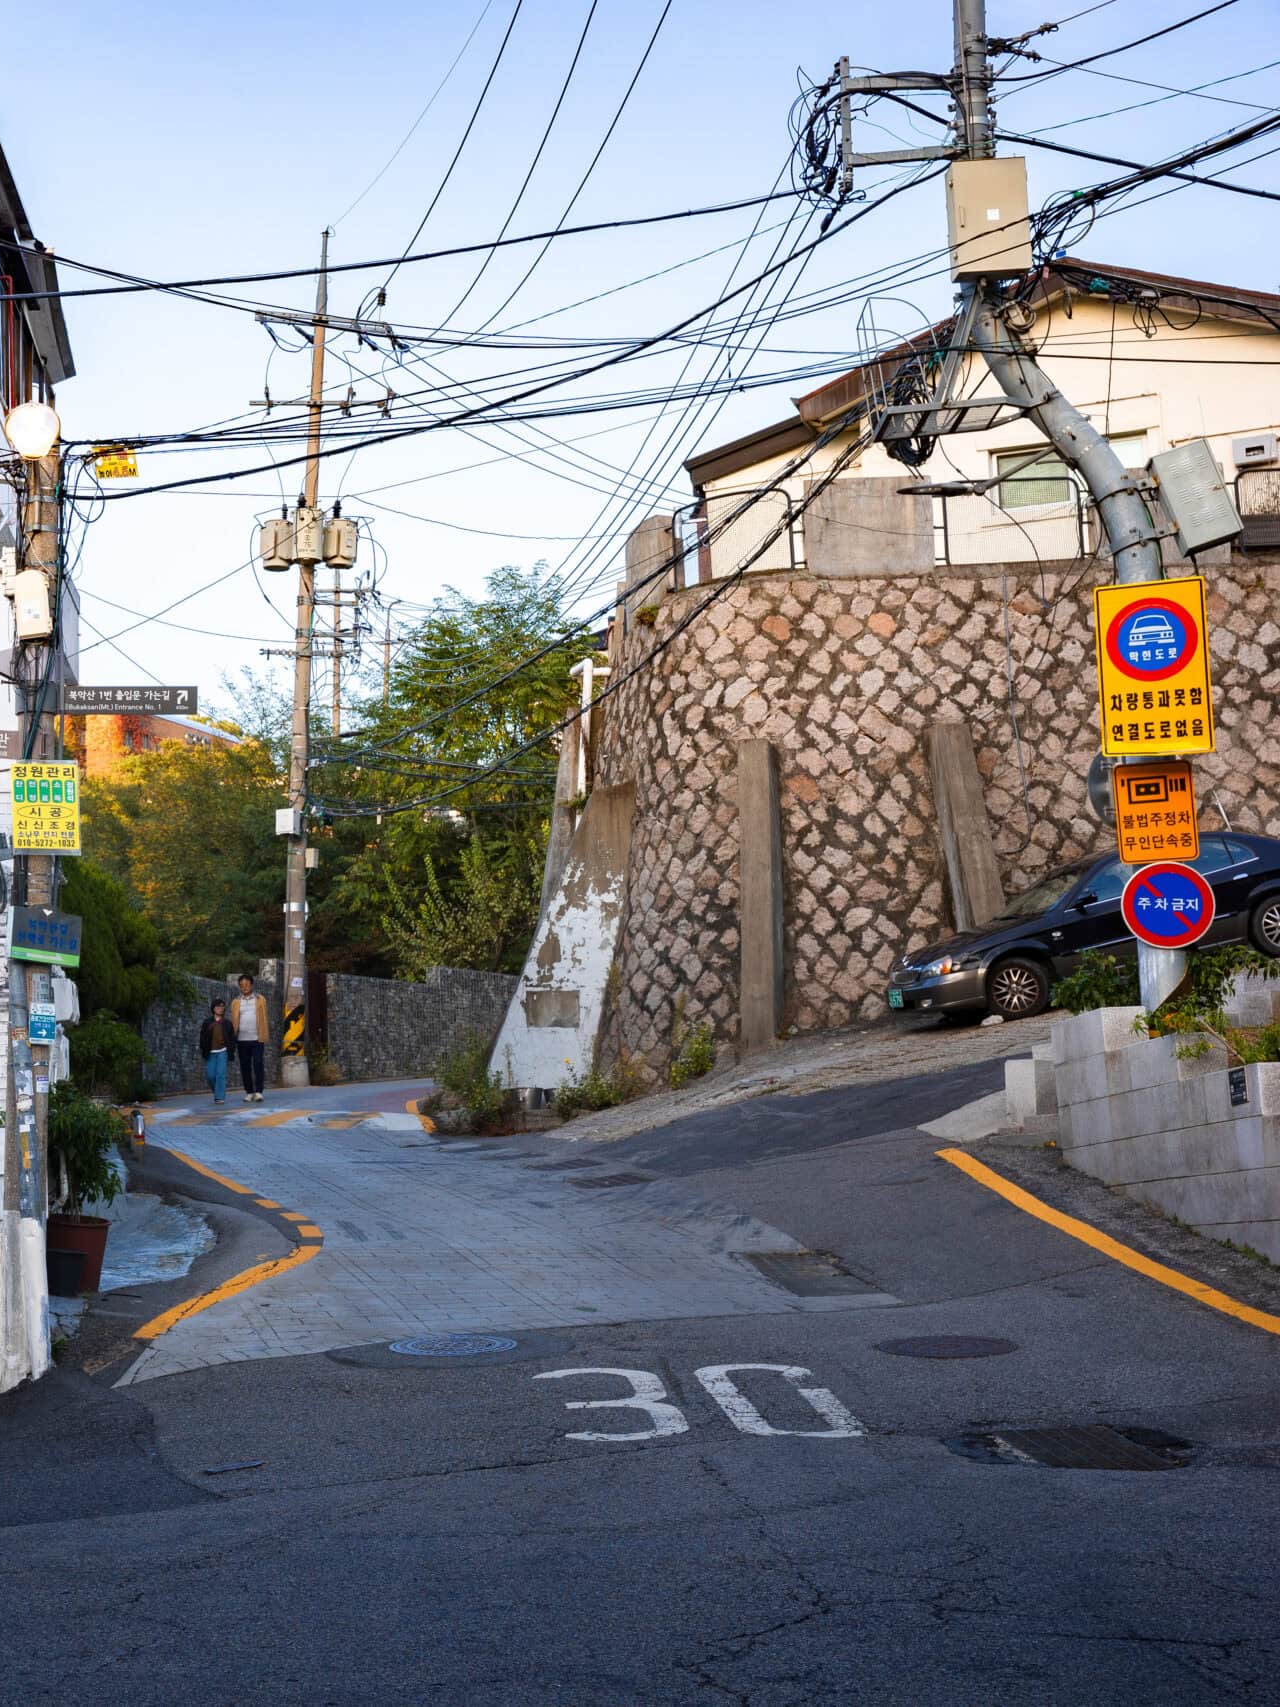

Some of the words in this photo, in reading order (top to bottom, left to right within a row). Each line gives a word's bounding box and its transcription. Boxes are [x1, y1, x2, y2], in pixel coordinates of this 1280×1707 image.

[1129, 648, 1177, 662] 막힌도로
[1110, 688, 1202, 712] 차량통과못함
[1112, 718, 1204, 742] 연결도로없음
[14, 766, 75, 778] 정원관리
[1123, 810, 1191, 829] 불법주정차
[1124, 832, 1193, 851] 무인단속중
[532, 1363, 868, 1441] 30
